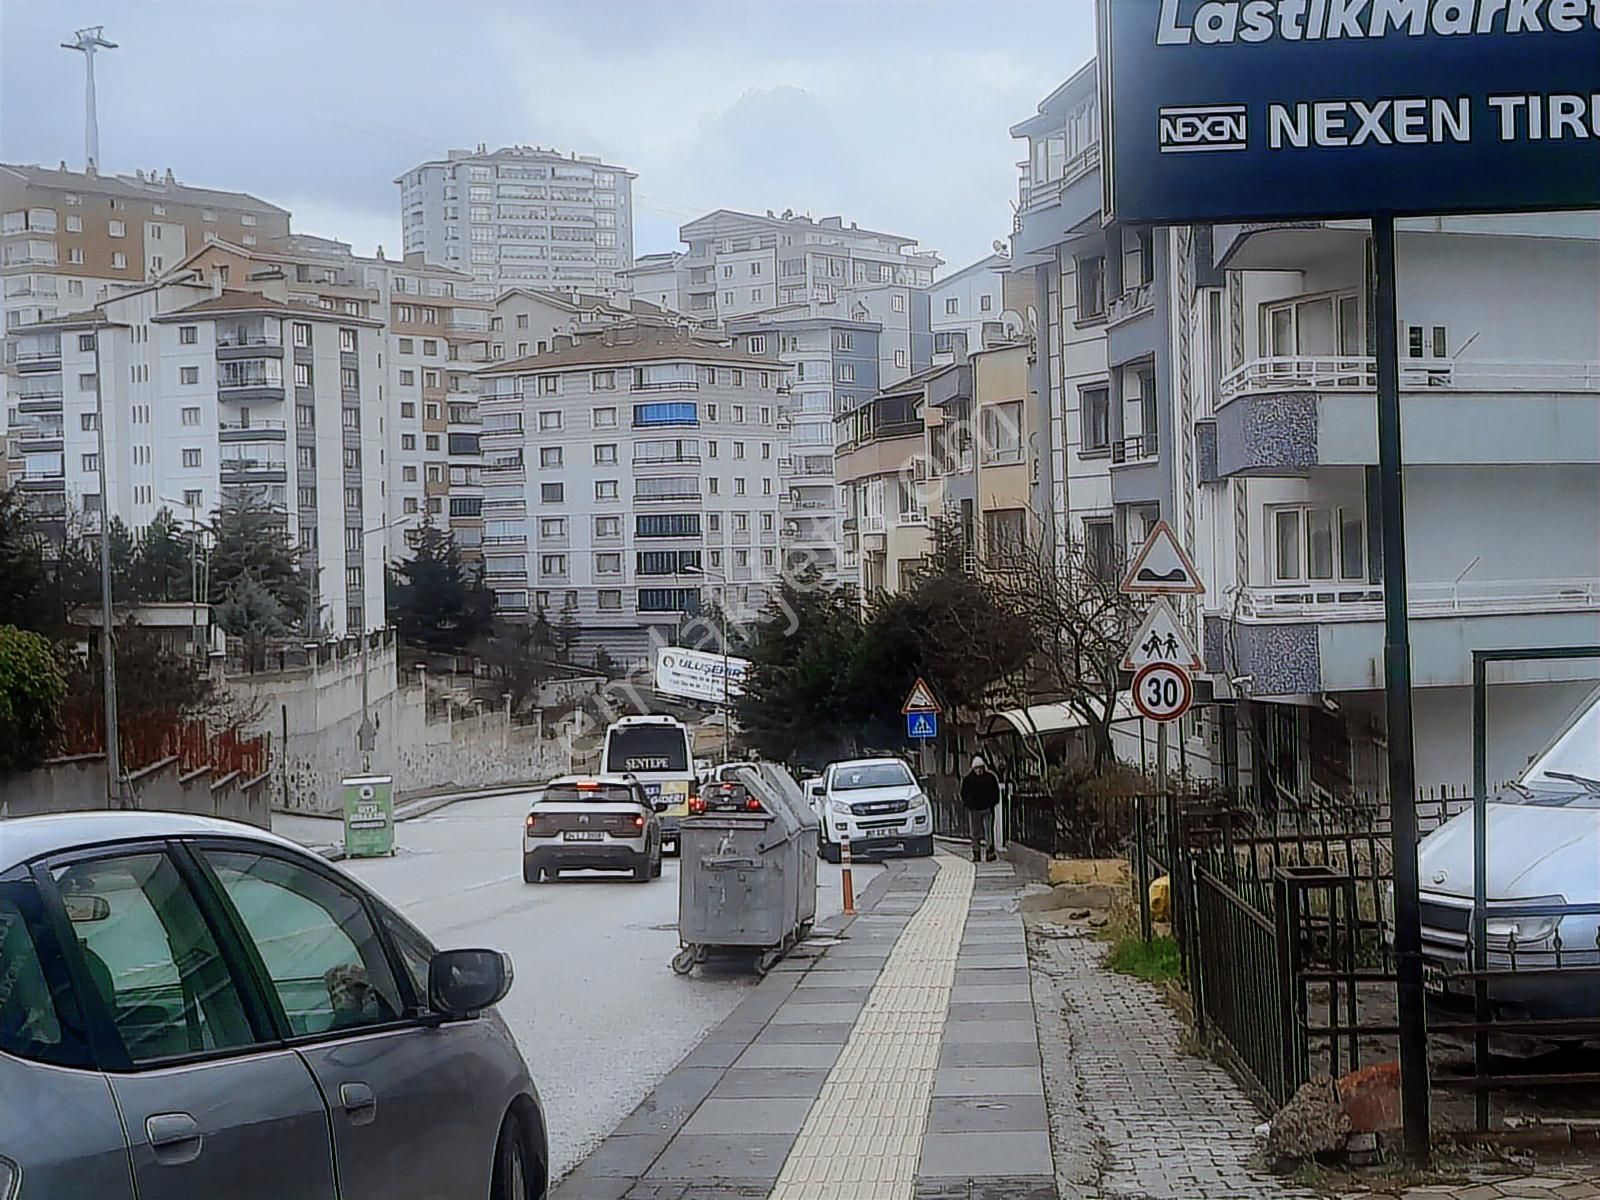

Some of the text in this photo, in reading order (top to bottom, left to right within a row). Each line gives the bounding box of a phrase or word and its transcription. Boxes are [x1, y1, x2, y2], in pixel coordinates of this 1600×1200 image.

[1270, 98, 1471, 149] NEXEN
[1488, 94, 1600, 140] TIR
[1147, 677, 1178, 708] 30
[625, 757, 670, 771] ŞENTEPE
